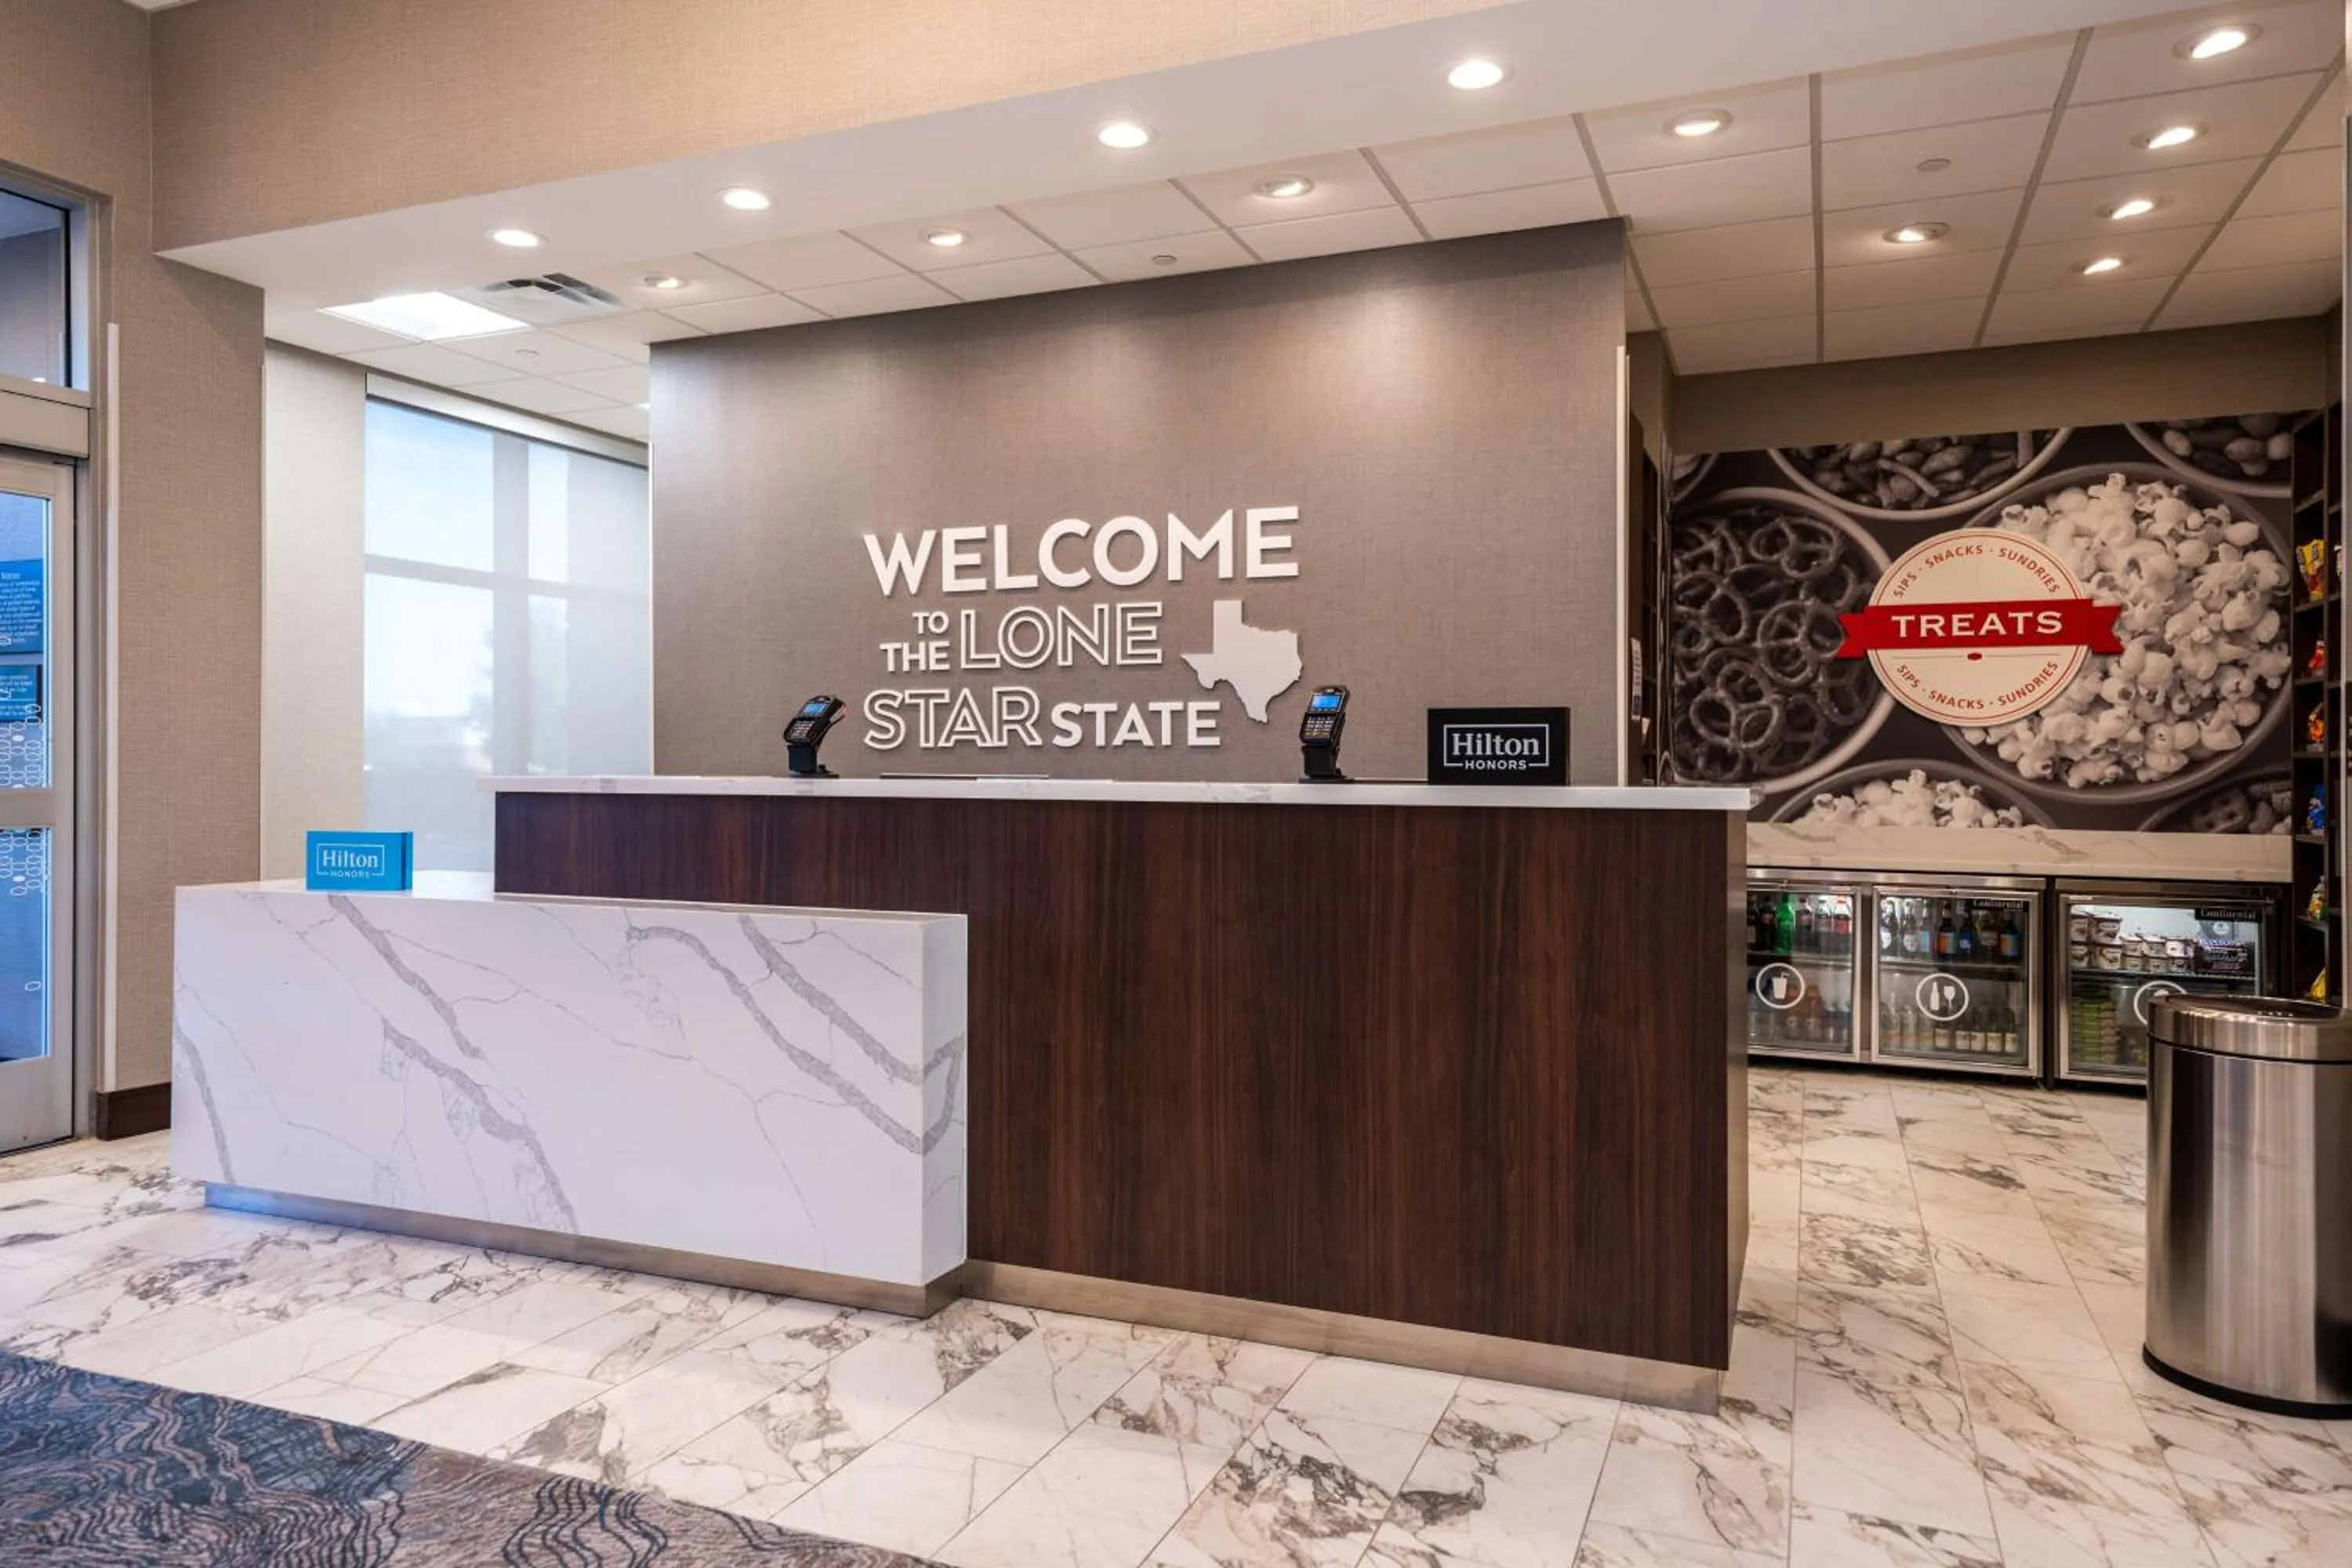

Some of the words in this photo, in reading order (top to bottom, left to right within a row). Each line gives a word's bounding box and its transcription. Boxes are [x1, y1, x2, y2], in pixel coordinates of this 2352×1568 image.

[863, 506, 1299, 597] WELCOME
[1893, 572, 1917, 598] SIPS
[1925, 545, 1984, 568] SNACKS
[1998, 547, 2060, 593] SUNDRIES
[913, 611, 949, 634] TO
[1891, 610, 2063, 638] TREATS
[880, 641, 950, 673] THE
[960, 601, 1163, 670] LONE
[1897, 664, 1920, 688] SIPS
[1929, 689, 1984, 710] SNACKS
[1997, 661, 2059, 706] SUNDRIES
[864, 686, 1044, 750] STAR
[1051, 701, 1221, 747] STATE
[1452, 733, 1541, 756] Hilton
[1465, 760, 1527, 770] HONORS
[322, 849, 379, 868] Hilton
[330, 869, 371, 878] HONORS
